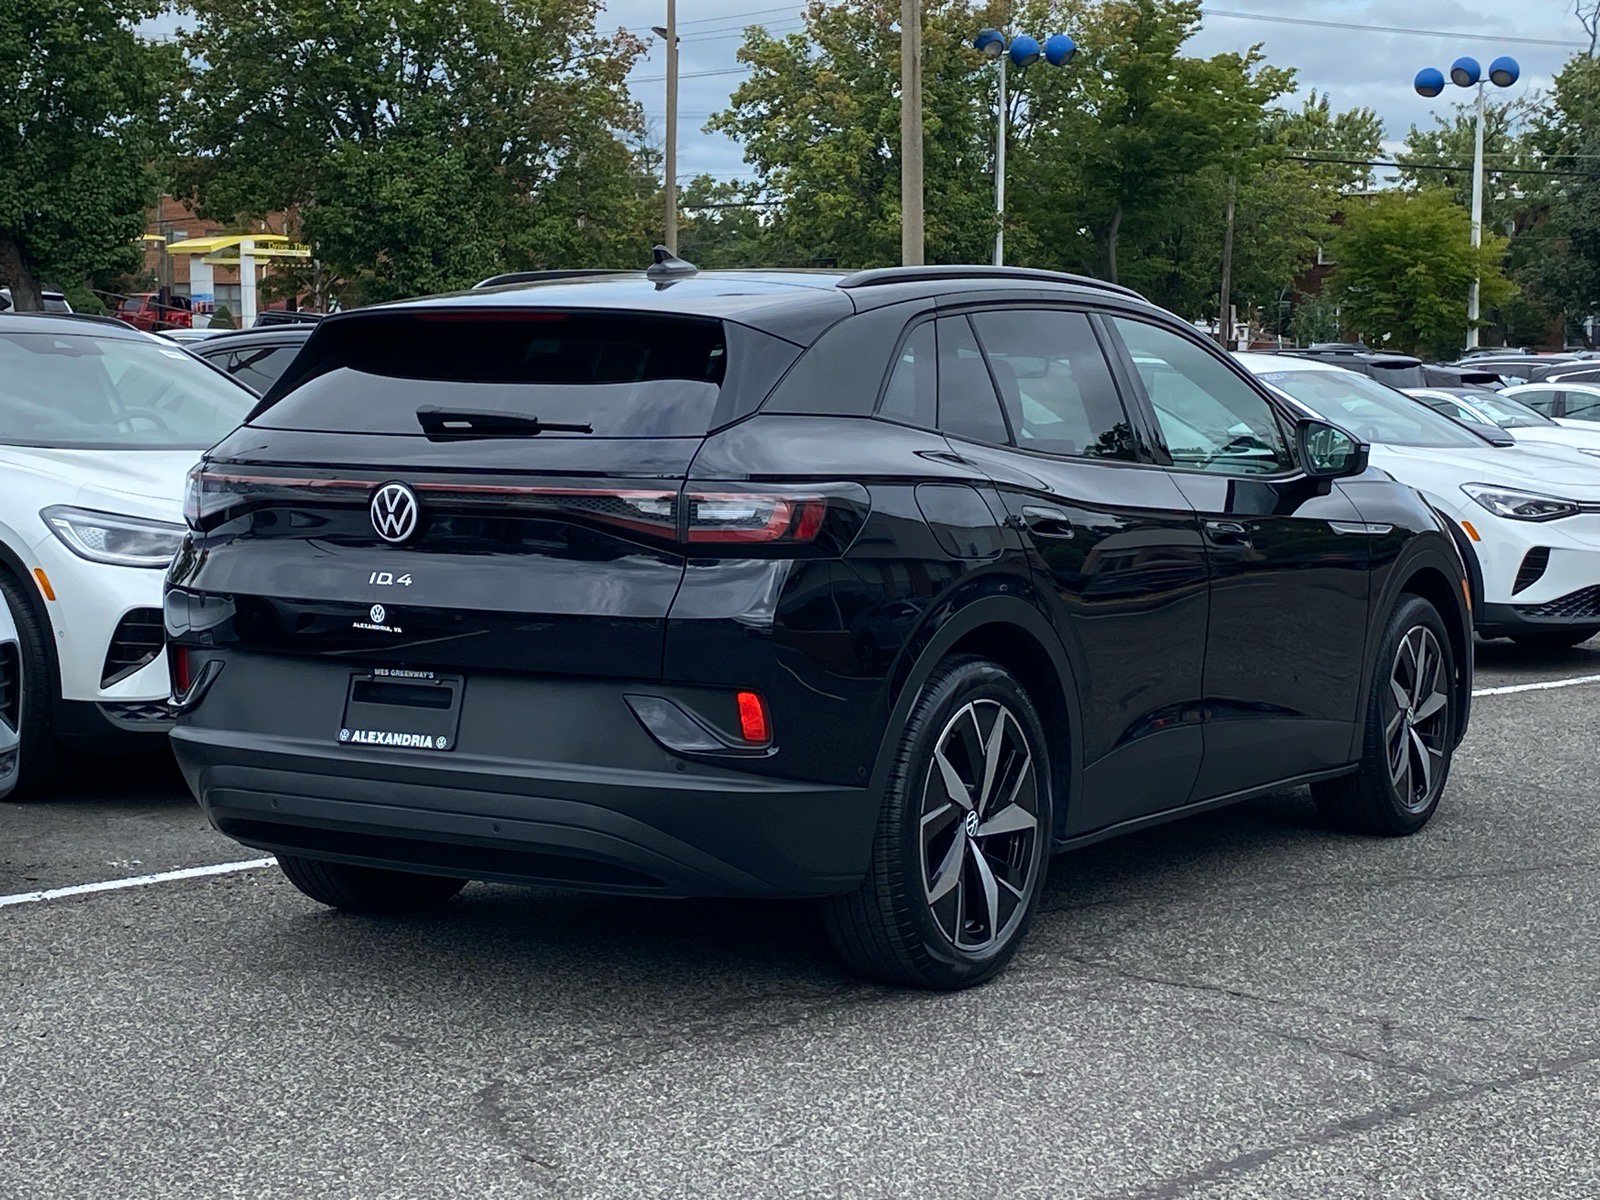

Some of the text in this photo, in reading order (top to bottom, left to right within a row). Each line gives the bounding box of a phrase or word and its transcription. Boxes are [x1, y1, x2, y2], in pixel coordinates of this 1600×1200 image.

[374, 668, 434, 679] WES GREENWAY'S
[351, 730, 433, 748] ALEXANDRIA
